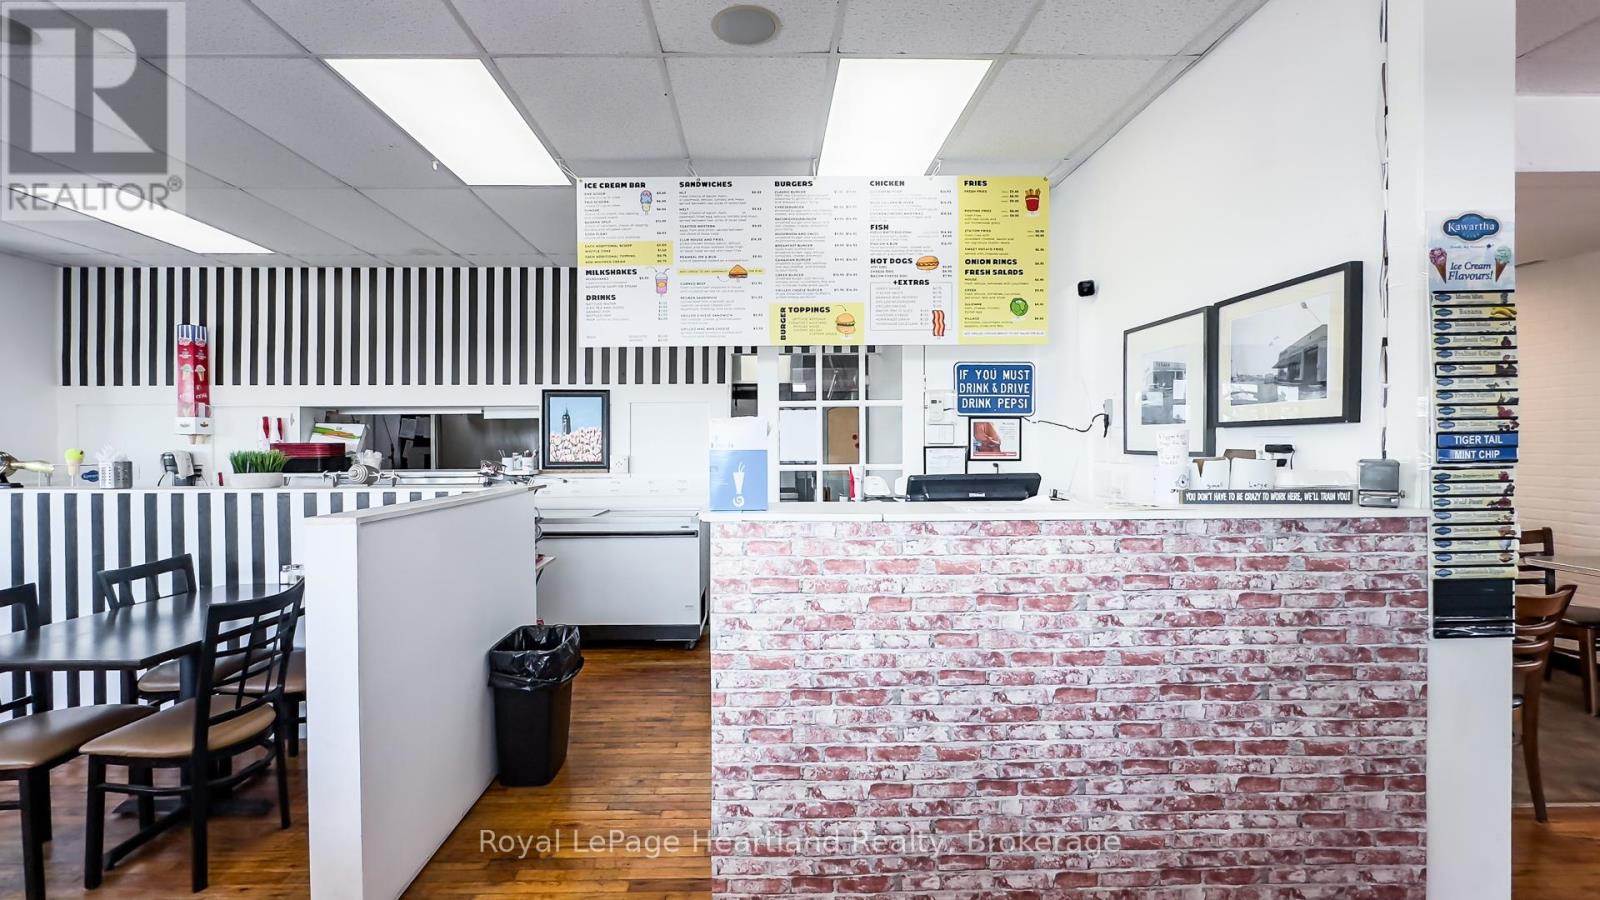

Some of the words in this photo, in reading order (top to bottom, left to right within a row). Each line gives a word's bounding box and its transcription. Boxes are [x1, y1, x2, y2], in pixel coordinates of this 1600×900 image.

[1448, 222, 1495, 233] Kawartha
[1450, 262, 1462, 270] Ice
[1464, 261, 1492, 270] Cream
[1448, 270, 1494, 281] Flavours!
[959, 369, 969, 380] IF
[975, 369, 997, 380] YOU
[1002, 369, 1030, 380] MUST
[959, 383, 989, 394] DRINK
[992, 383, 998, 393] &
[1000, 383, 1030, 393] DRIVE
[962, 398, 991, 408] DRINK
[997, 398, 1028, 408] PEPSI
[1454, 436, 1481, 444] TIGER
[1484, 435, 1503, 444] TAIL
[1454, 451, 1476, 459] MINT
[1479, 450, 1500, 458] CHIP
[1185, 492, 1196, 501] YOU
[1197, 492, 1212, 501] DON'T
[1213, 492, 1227, 501] HAVE
[1229, 492, 1235, 501] TO
[1237, 492, 1243, 501] BE
[1244, 492, 1261, 501] CRAZY
[1262, 492, 1269, 501] TO
[1271, 492, 1287, 501] WORK
[1287, 492, 1303, 501] HERE,
[1304, 492, 1319, 501] WE'LL
[1320, 492, 1336, 501] TRAIN
[1337, 492, 1351, 501] YOU!
